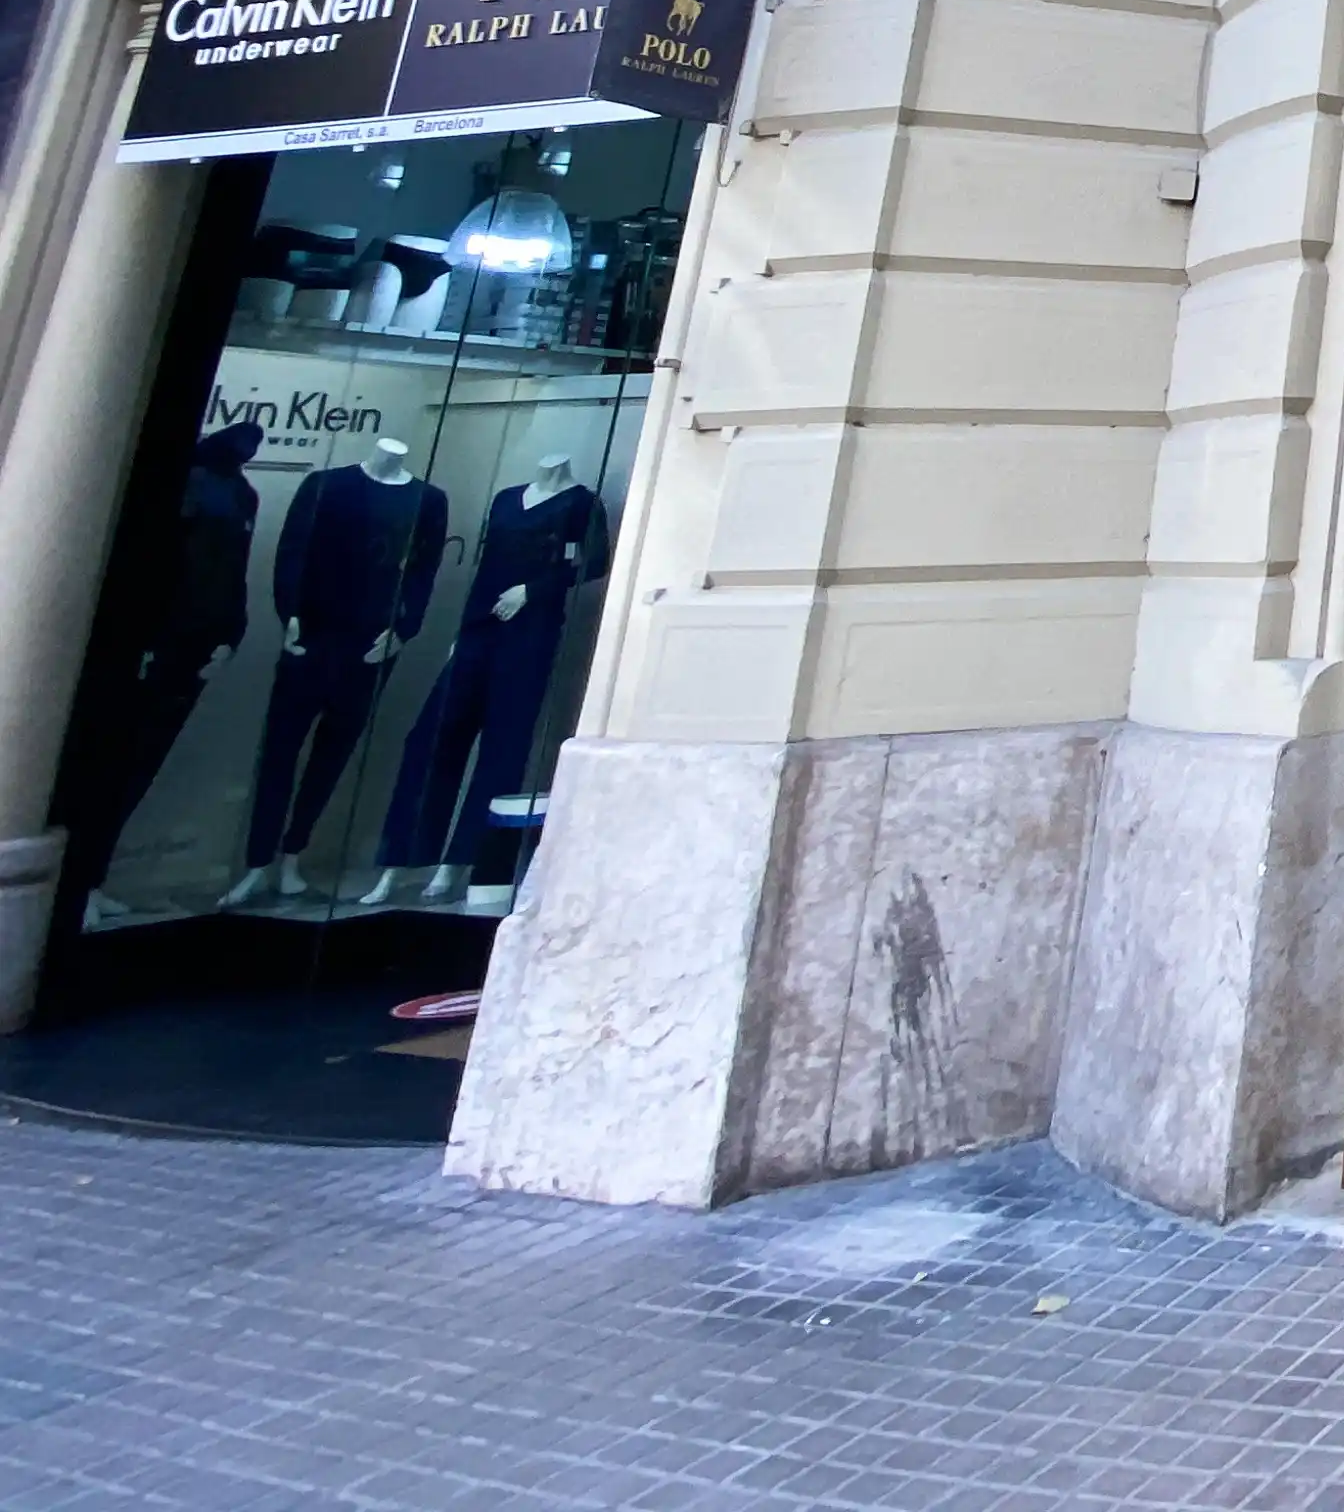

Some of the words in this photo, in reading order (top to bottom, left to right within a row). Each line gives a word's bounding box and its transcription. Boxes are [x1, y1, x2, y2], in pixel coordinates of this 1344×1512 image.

[423, 13, 534, 48] RALPH
[194, 33, 343, 66] underwear
[640, 33, 712, 70] POLO
[284, 131, 317, 146] Casa
[413, 116, 484, 134] Barcelona
[286, 391, 382, 434] Klein
